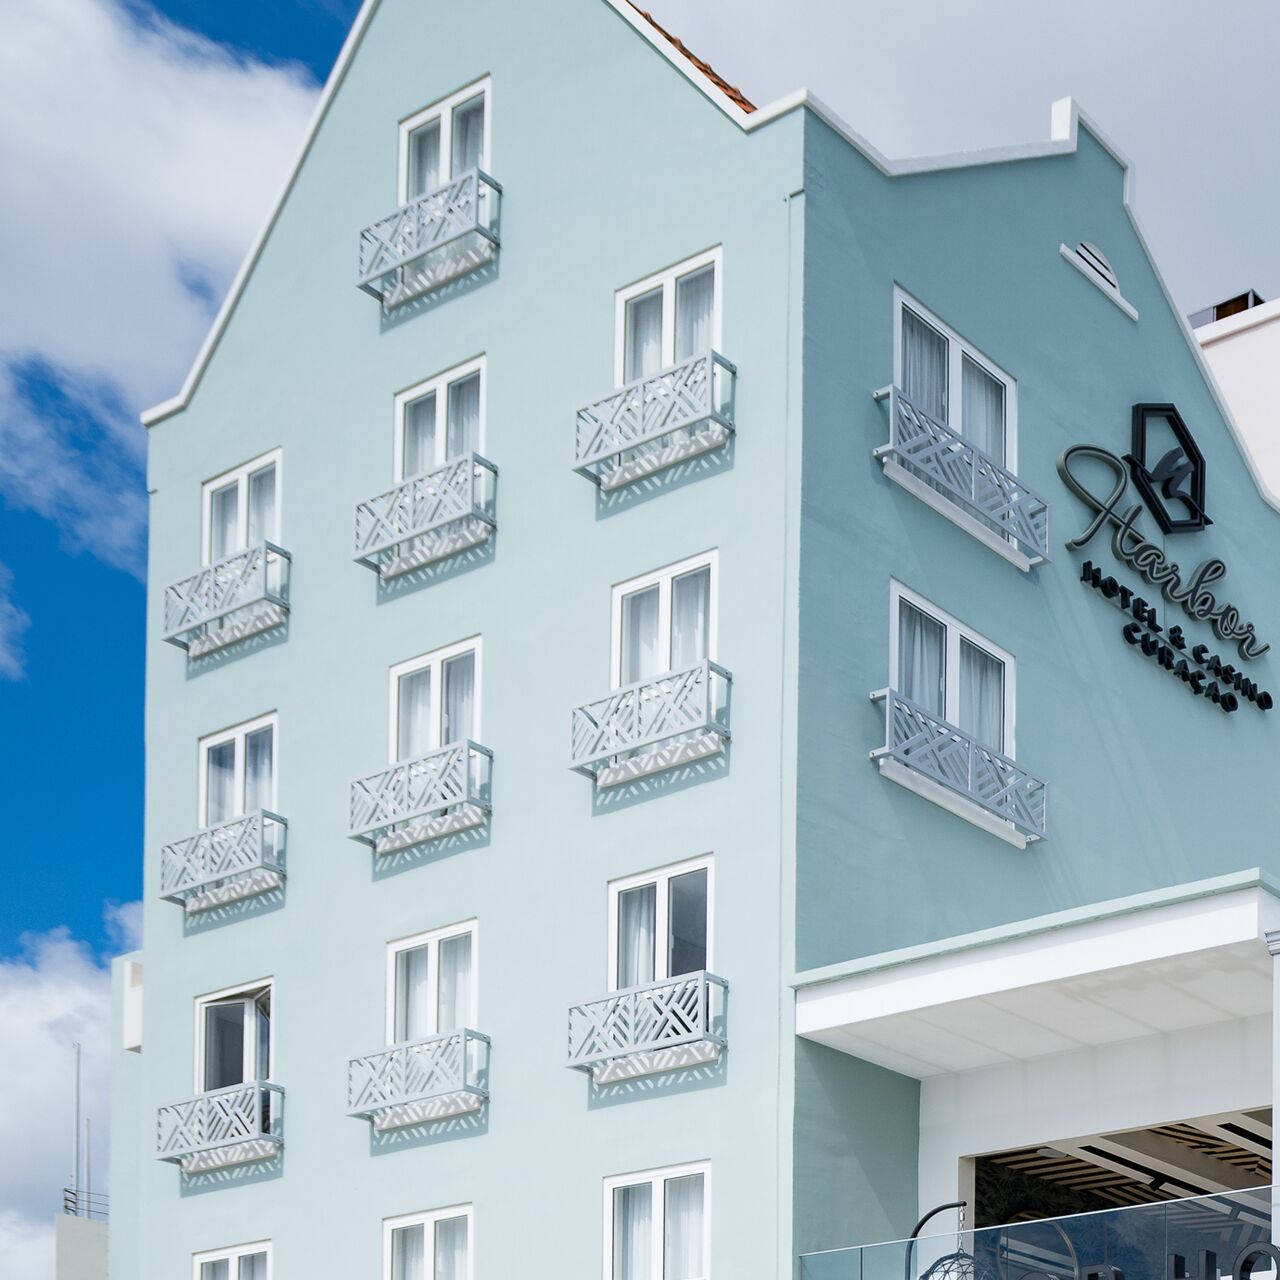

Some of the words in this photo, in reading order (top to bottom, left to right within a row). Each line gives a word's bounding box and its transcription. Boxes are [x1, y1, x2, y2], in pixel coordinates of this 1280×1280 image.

[1057, 444, 1270, 660] Harbor
[1080, 561, 1163, 633] HOTEL
[1169, 625, 1187, 650] &
[1192, 644, 1273, 711] CASINO
